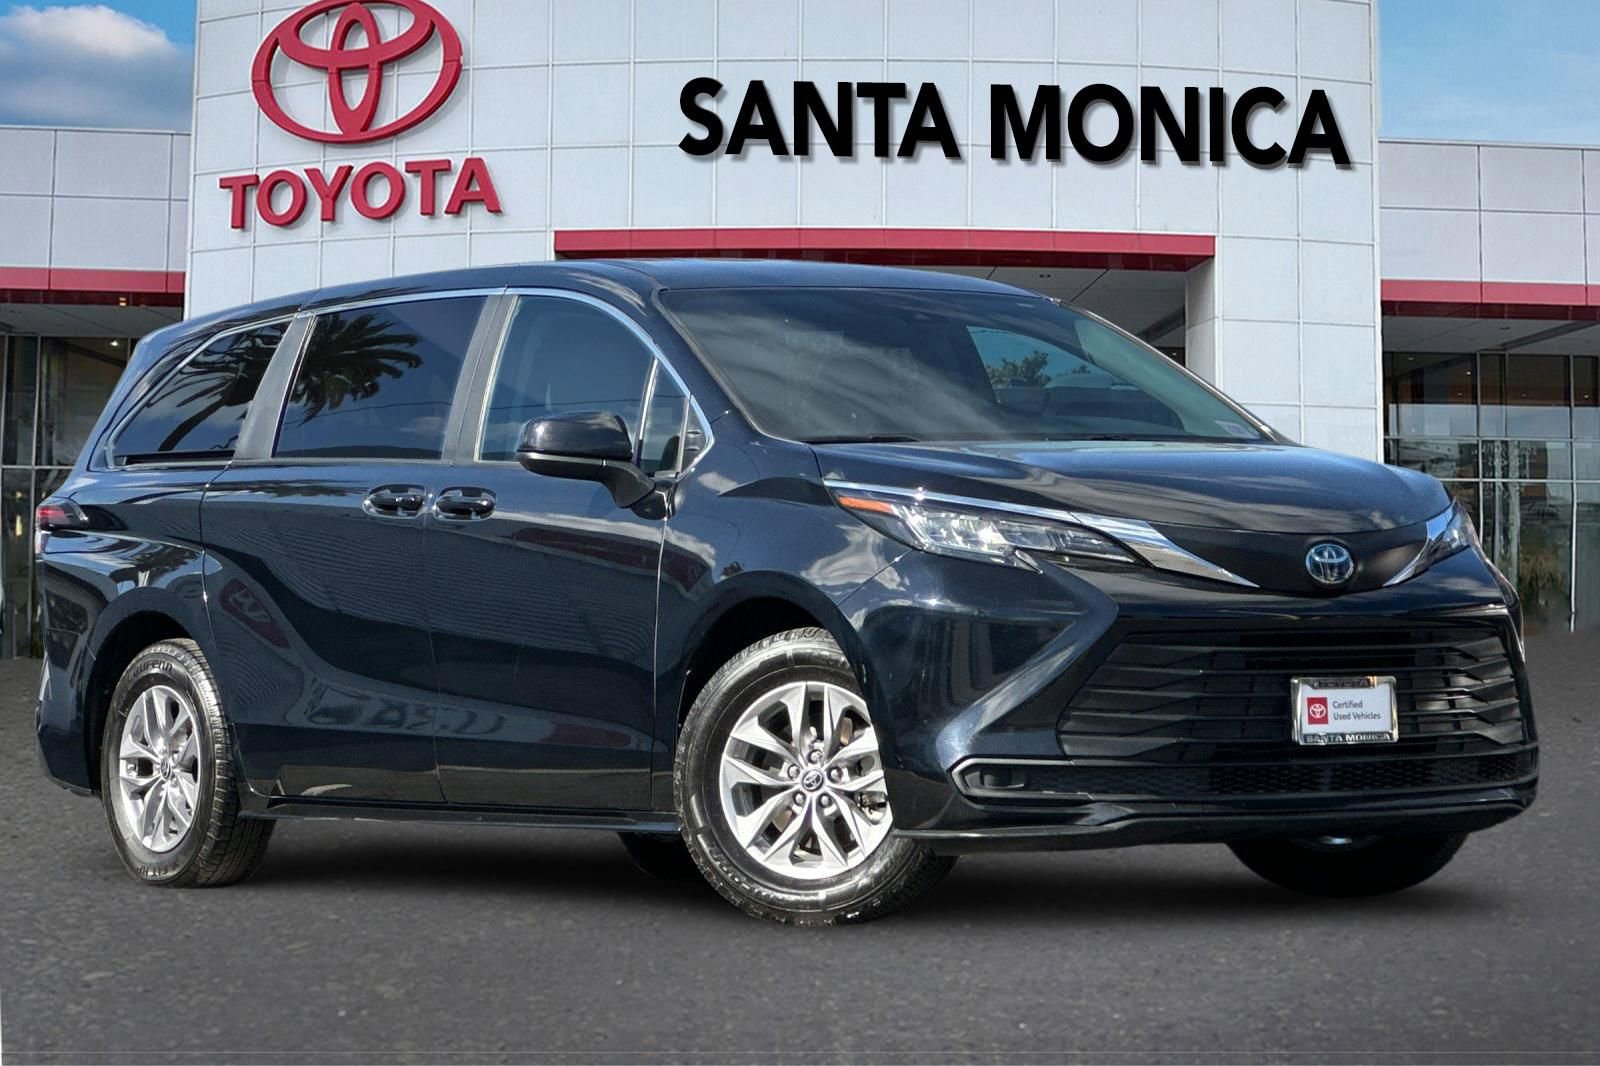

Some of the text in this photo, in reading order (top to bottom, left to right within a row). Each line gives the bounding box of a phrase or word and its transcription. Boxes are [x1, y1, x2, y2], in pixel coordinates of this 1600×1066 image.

[679, 77, 1352, 168] SANTA MONICA
[219, 157, 502, 230] TOYOTA
[1332, 700, 1363, 709] Certified
[1332, 711, 1381, 720] Used Vehicles
[1305, 732, 1391, 743] SANTA MONICA
